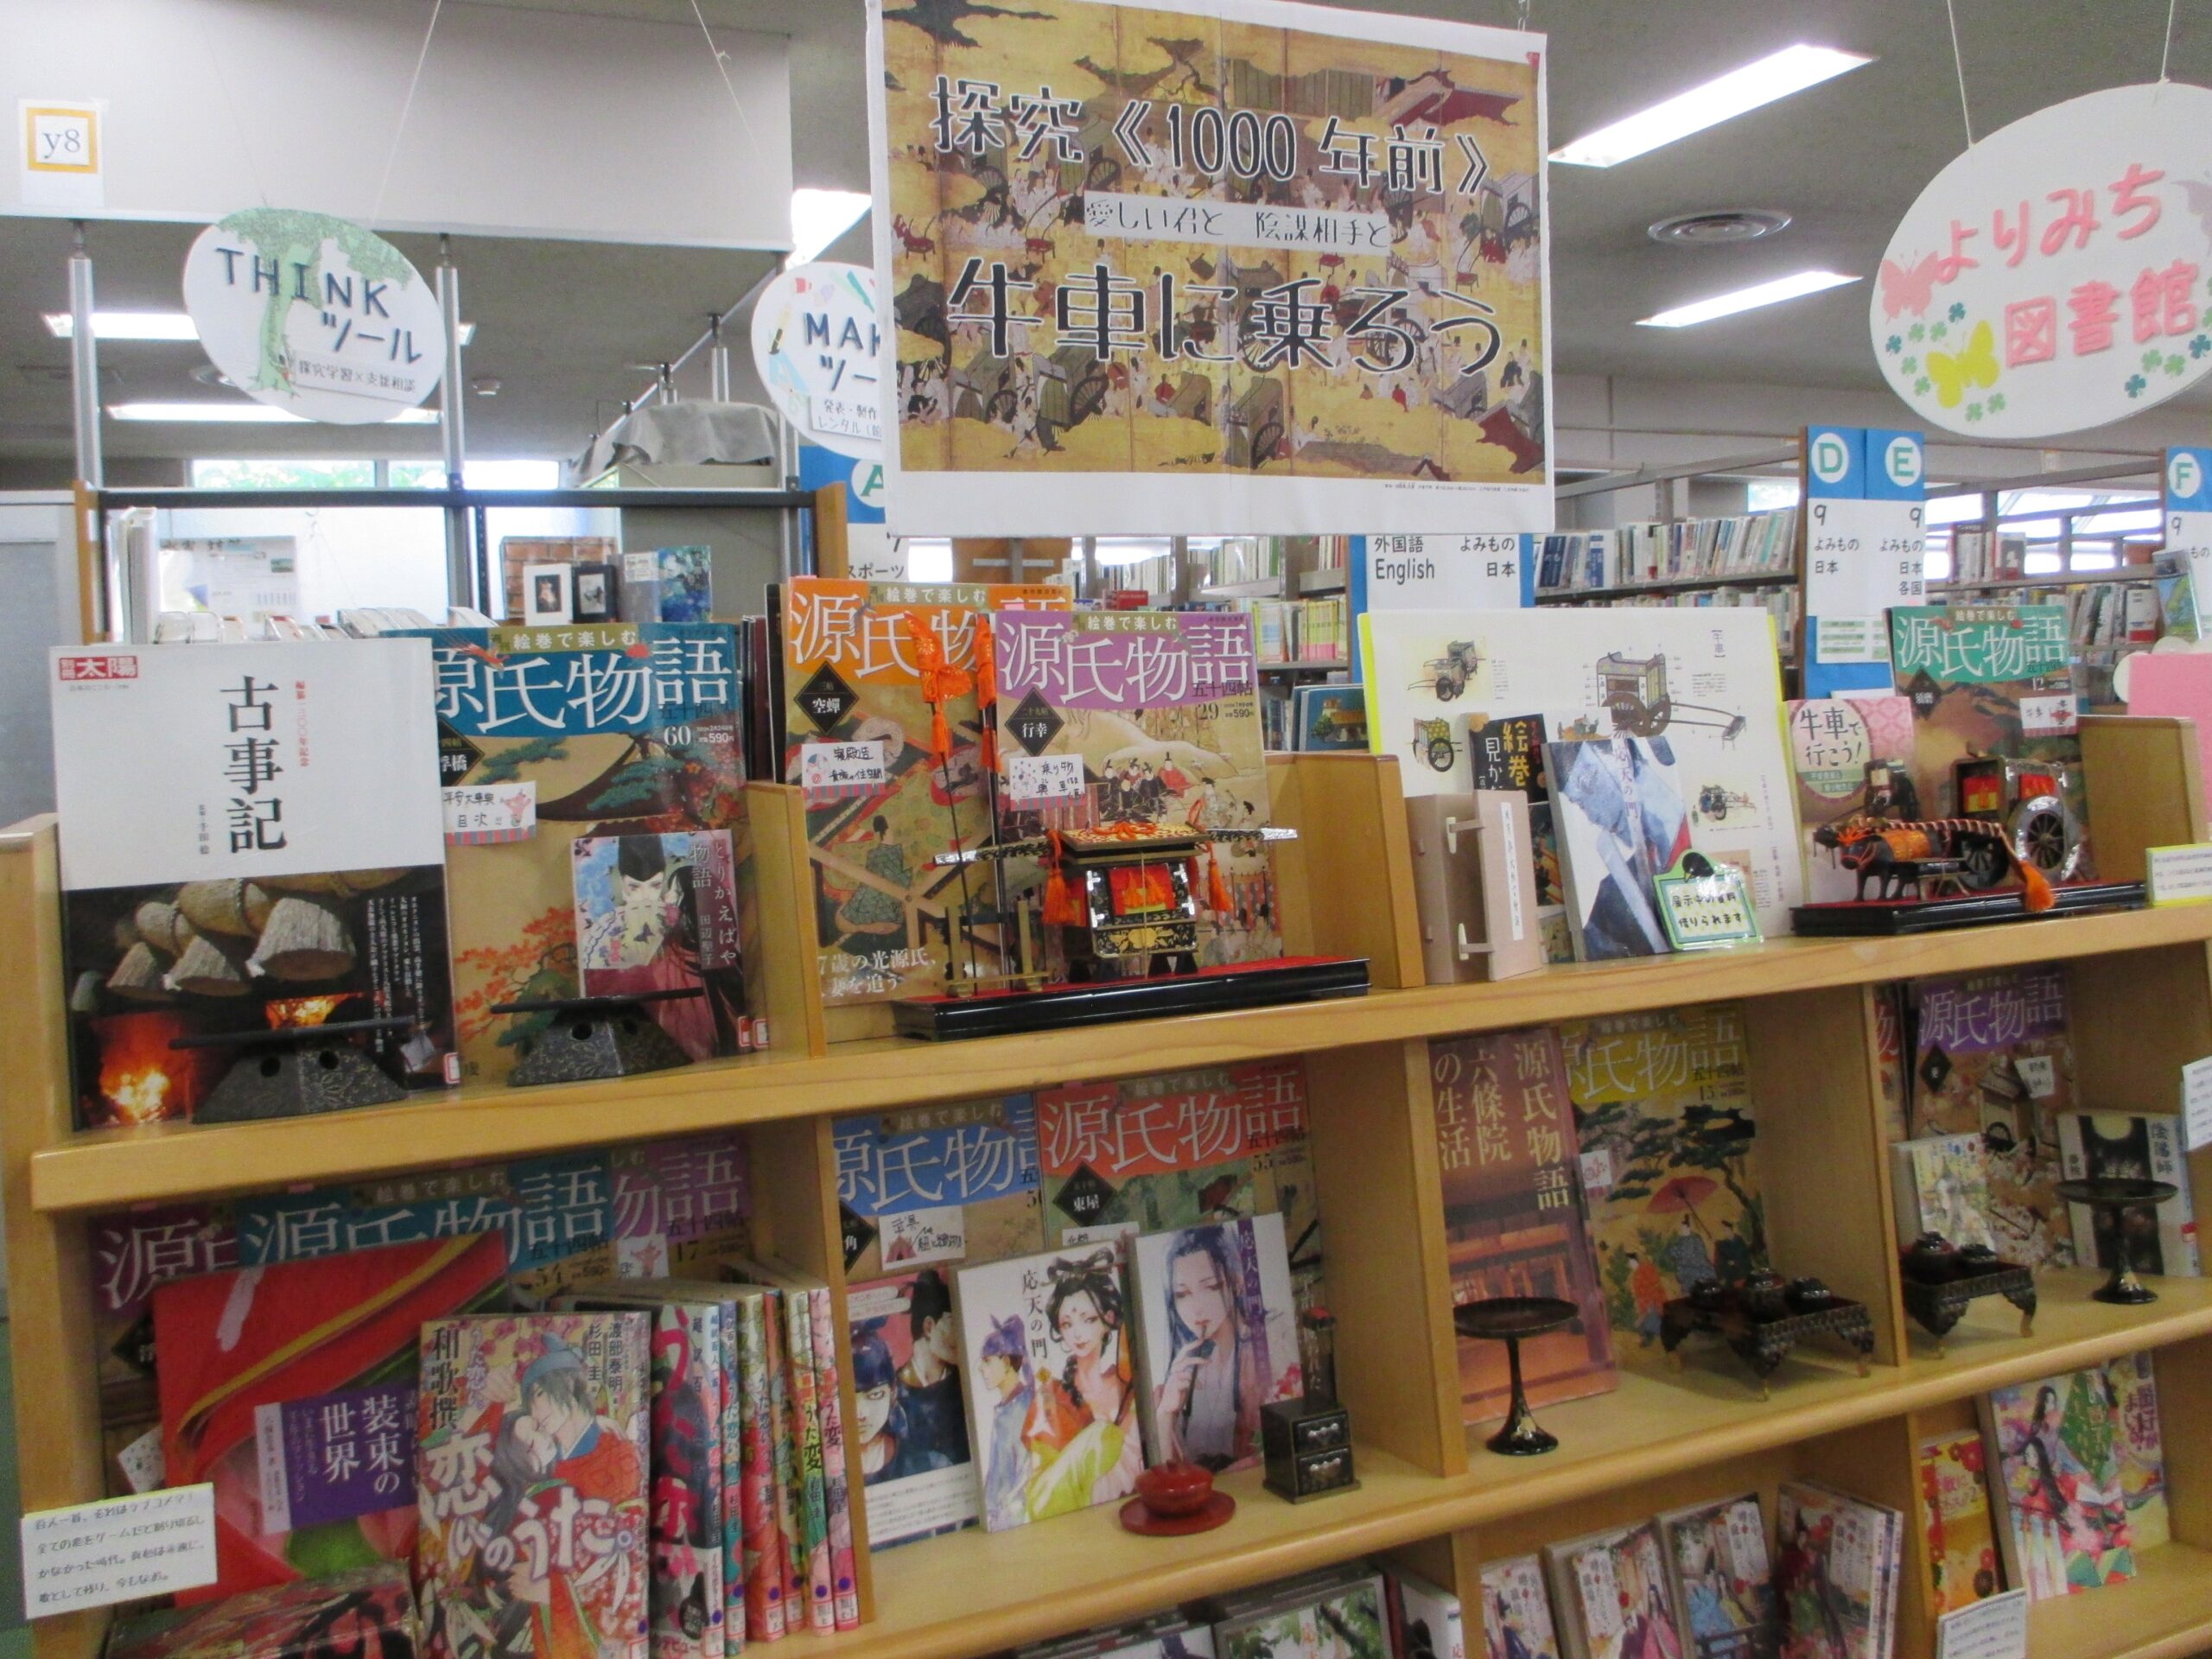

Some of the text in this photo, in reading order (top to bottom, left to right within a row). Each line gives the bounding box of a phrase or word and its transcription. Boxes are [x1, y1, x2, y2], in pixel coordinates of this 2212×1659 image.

[42, 127, 81, 157] y8
[1085, 199, 1389, 250] 愛しい君と 陰謀相手と
[1936, 162, 2165, 284] よりみち
[216, 247, 389, 318] THINK
[946, 257, 1503, 377] 牛車に乗ろう
[2004, 258, 2200, 369] 図書館
[321, 311, 421, 365] ツール
[1818, 442, 1843, 474] D
[1893, 447, 1914, 477] E
[861, 464, 883, 496] A
[2176, 462, 2193, 489] F
[1815, 505, 1827, 525] 9
[1910, 507, 1922, 528] 9
[2171, 517, 2182, 536] 9
[1375, 536, 1423, 553] 外国語
[1460, 537, 1515, 552] よみもの
[1815, 537, 1859, 551] よみもの
[1879, 538, 1923, 552] よみもの
[1376, 559, 1434, 585] English
[1486, 561, 1516, 578] 日本
[1815, 560, 1839, 575] 日本
[1900, 562, 1922, 575] 日本
[887, 588, 985, 603] 絵巻で楽しむ
[1898, 581, 1922, 595] 各国
[514, 630, 639, 650] 絵巻で楽しむ
[790, 591, 1066, 678] 源氏物
[1087, 616, 1177, 632] 絵巻で楽しむ
[1896, 615, 2066, 678] 源氏物語
[76, 658, 137, 677] 太陽
[1000, 623, 1253, 704] 源氏物語
[435, 637, 732, 733] 源氏物語
[1197, 703, 1219, 720] 29
[1800, 707, 1861, 741] 牛車で
[664, 726, 691, 746] 60
[1022, 722, 1048, 738] 行幸
[219, 676, 288, 854] 古事記
[1503, 721, 1529, 786] 絵巻
[691, 842, 712, 887] 物語
[715, 842, 736, 964] とりかえばや
[1679, 913, 1742, 928] 借りられます
[1920, 973, 2063, 1049] 源氏物語
[1042, 1071, 1303, 1173] 源氏物語
[1434, 1052, 1470, 1170] の生活
[1515, 1039, 1570, 1210] 源氏物語
[1073, 1194, 1099, 1212] 東屋
[1240, 1230, 1263, 1315] 応天の門
[1022, 1268, 1048, 1359] 応天の門
[588, 1322, 602, 1381] 杉田圭
[319, 1402, 360, 1484] 世界
[362, 1394, 405, 1494] 装束の
